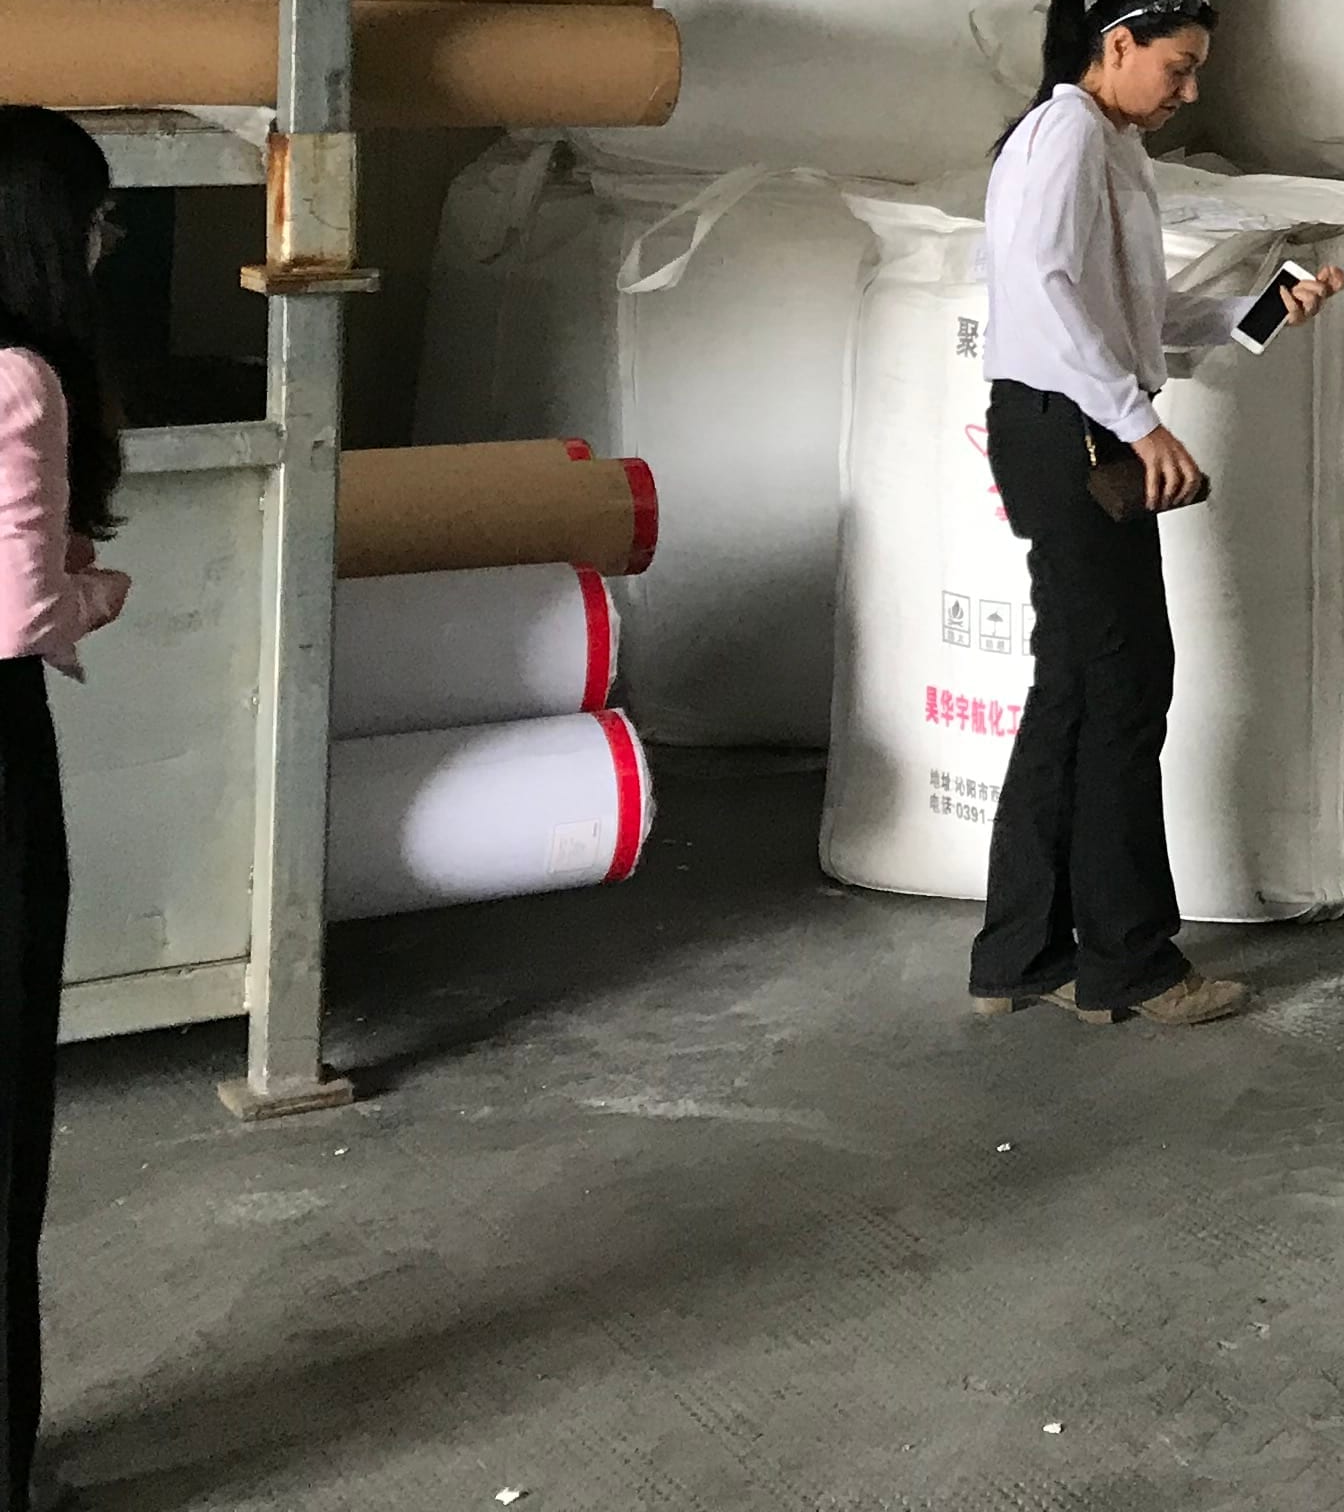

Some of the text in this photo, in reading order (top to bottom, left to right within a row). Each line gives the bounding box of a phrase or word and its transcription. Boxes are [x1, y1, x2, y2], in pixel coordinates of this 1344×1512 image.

[925, 685, 1022, 737] 昊华宇航化工
